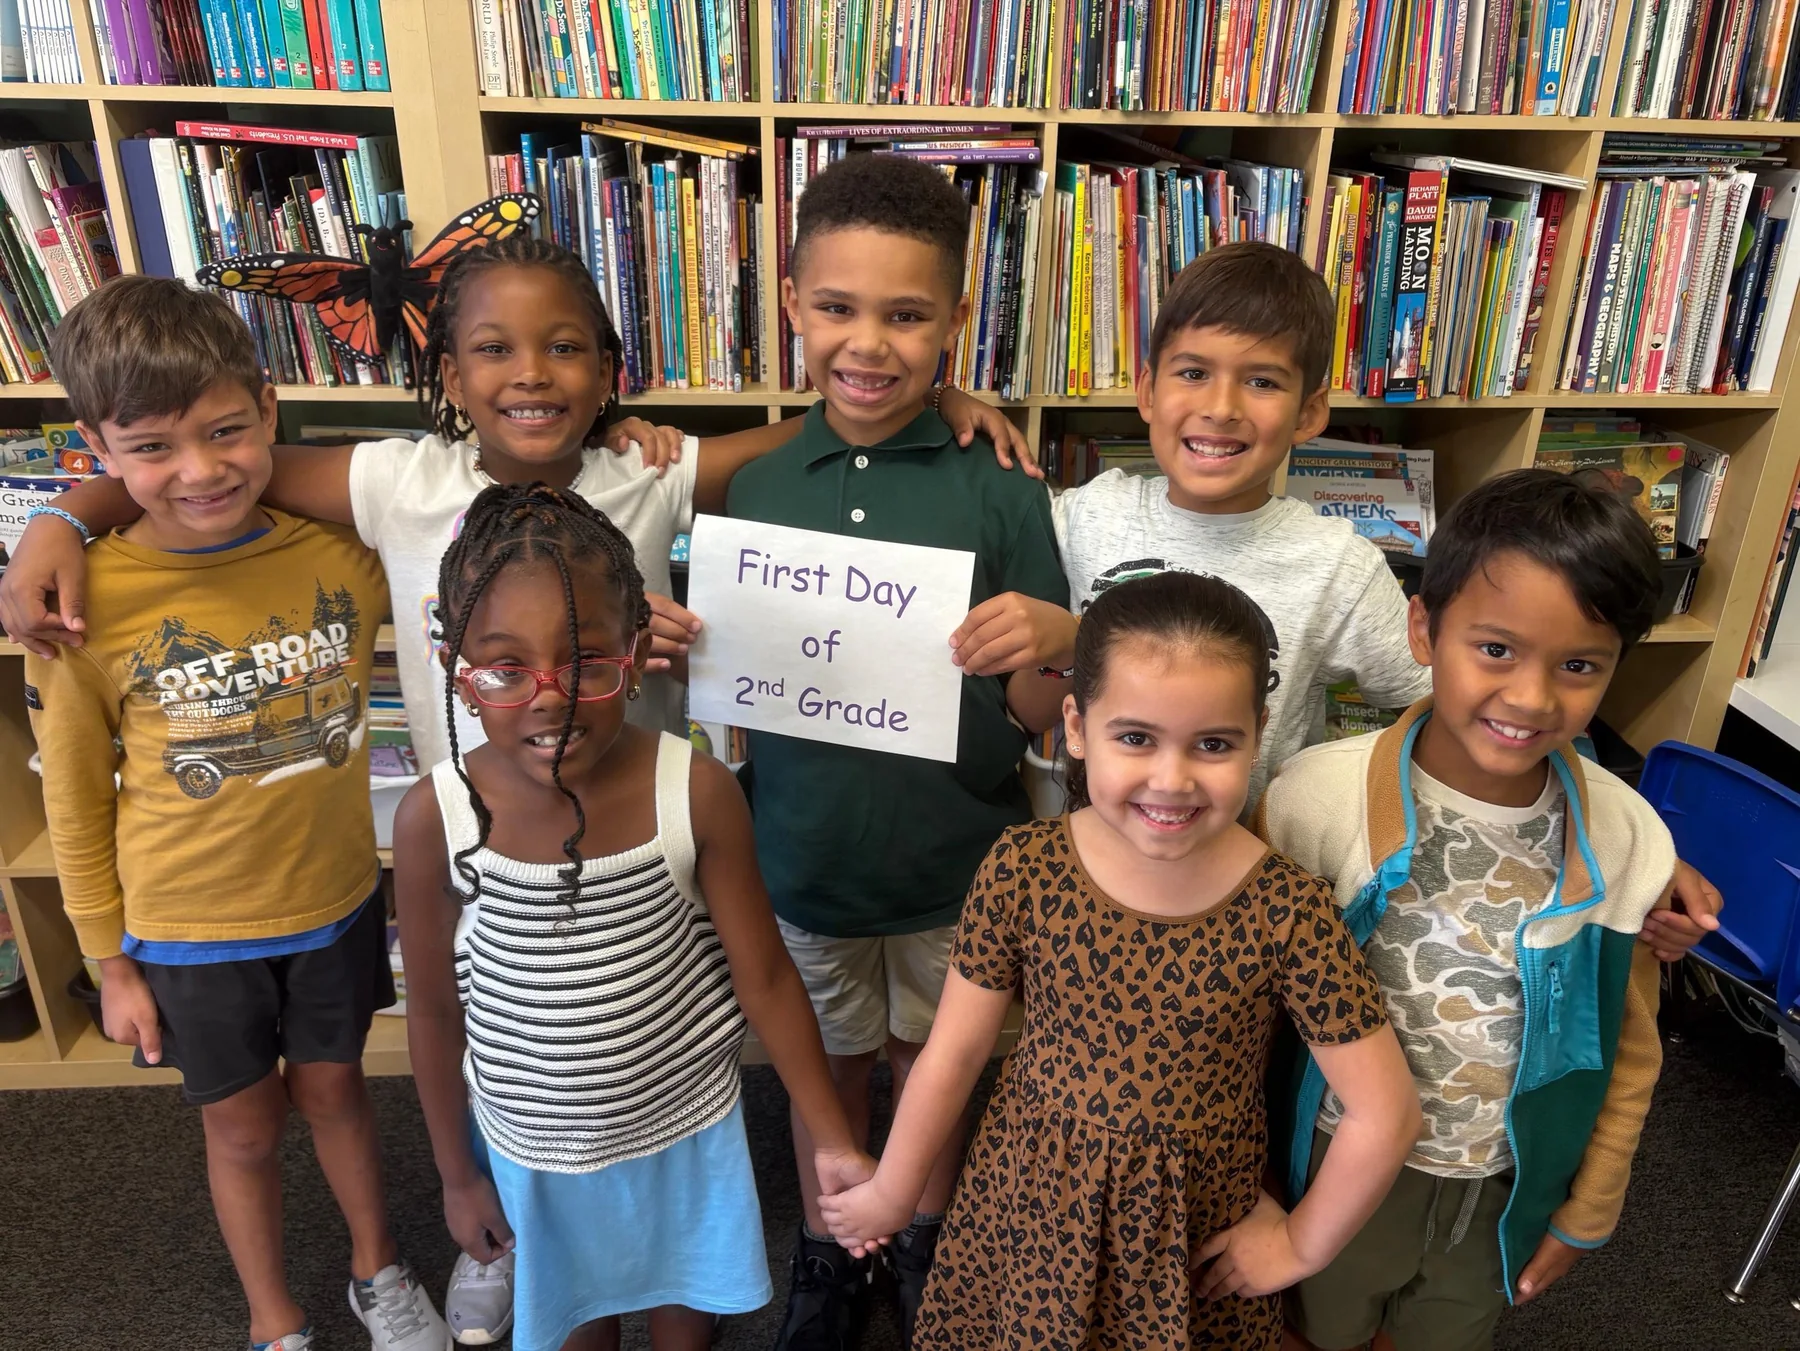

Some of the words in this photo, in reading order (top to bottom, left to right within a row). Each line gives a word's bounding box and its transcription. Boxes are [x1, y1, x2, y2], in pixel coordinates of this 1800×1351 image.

[558, 12, 567, 34] Seuss
[583, 10, 591, 32] Seuss
[249, 131, 281, 142] Presidents
[281, 133, 294, 143] U.S.
[849, 127, 870, 136] LIVES
[871, 127, 880, 135] OF
[882, 126, 944, 135] EXTRAORDINARY
[945, 125, 974, 133] WOMEN
[795, 147, 803, 161] KEN
[795, 162, 803, 186] BURNS
[669, 180, 677, 207] MEETING
[1408, 191, 1439, 200] PLATT
[317, 206, 328, 225] IDA
[342, 200, 353, 226] HIDDEN
[670, 209, 678, 227] MANY
[1406, 205, 1437, 215] DAVID
[1597, 191, 1609, 224] Foundations
[1649, 194, 1660, 220] MEETING
[299, 194, 310, 219] PROFILES
[307, 228, 317, 246] GREAT
[1345, 214, 1357, 248] AMAZING
[1645, 222, 1654, 240] MANY
[290, 226, 300, 247] SMITH
[321, 228, 330, 239] B.
[671, 230, 679, 253] PEOPLE
[1591, 230, 1603, 255] American
[1672, 225, 1681, 246] SOCIAL
[594, 229, 605, 281] BARACK
[1399, 226, 1416, 291] LANDING
[1606, 242, 1622, 281] MAPS
[1642, 242, 1652, 264] PEOPLE
[1667, 247, 1677, 271] STUDIES
[686, 238, 697, 304] NEIGHBORHOODS
[1341, 264, 1352, 286] BUGS
[1586, 255, 1597, 275] History
[1619, 251, 1633, 287] UNITED
[1083, 275, 1091, 316] Celebrations
[1604, 283, 1614, 294] &
[1662, 272, 1672, 301] THROUGH
[1745, 282, 1753, 297] MANY
[1011, 290, 1019, 310] LOOK
[1612, 288, 1627, 322] STATES
[1738, 298, 1750, 323] COLORED
[620, 289, 631, 335] AMERICAN
[1657, 314, 1665, 328] YEAR
[1008, 328, 1017, 349] STARS
[1587, 295, 1612, 376] GEOGRAPHY
[1735, 324, 1744, 339] DAYS
[625, 335, 633, 357] STORY
[690, 318, 701, 369] COMMUNITIES
[1605, 322, 1620, 364] HISTORY
[53, 434, 63, 445] 3
[72, 457, 84, 471] 4
[1297, 458, 1331, 466] ANCIENT
[1314, 490, 1385, 505] Discovering
[1321, 502, 1397, 521] ATHENS
[737, 548, 830, 596] First
[845, 565, 917, 619] Day
[155, 650, 236, 690] OFF
[251, 622, 348, 667] ROAD
[801, 629, 841, 663] of
[159, 643, 350, 705] ADVENTURE
[187, 702, 247, 718] OUTDOORS
[735, 676, 785, 707] 2nd
[798, 686, 909, 732] Grade
[1340, 703, 1380, 717] Insect
[1341, 718, 1383, 732] Homes
